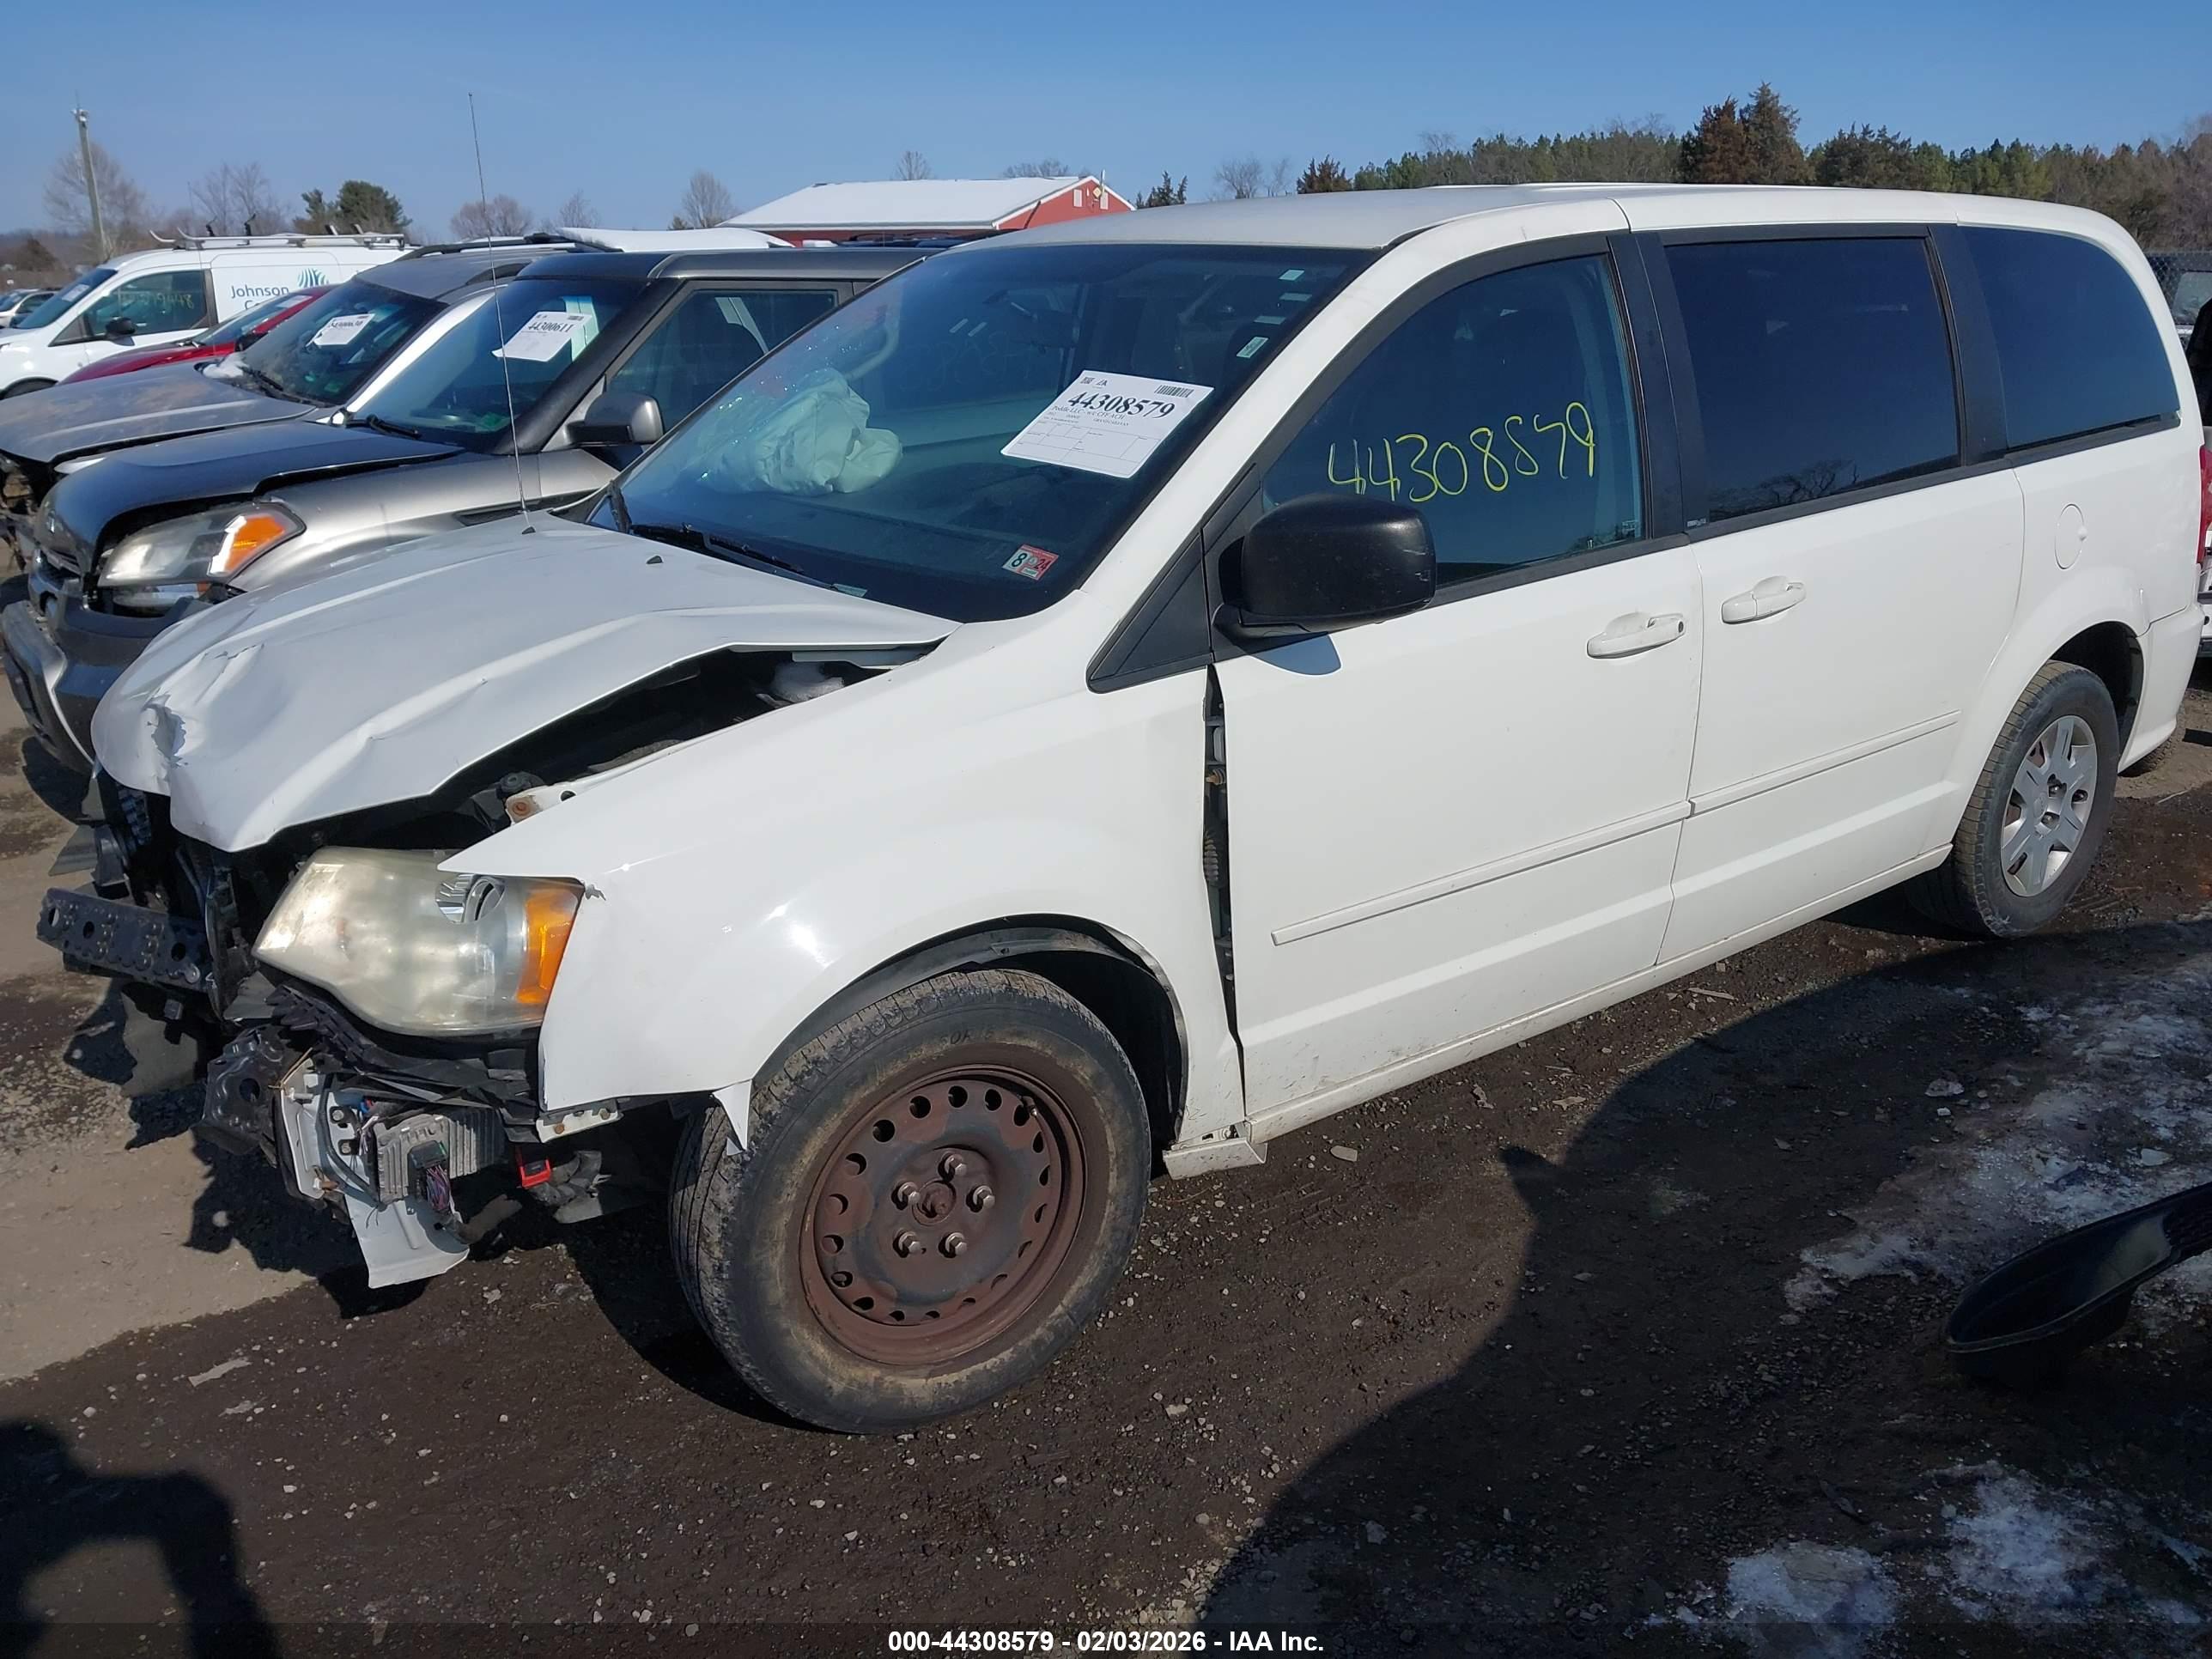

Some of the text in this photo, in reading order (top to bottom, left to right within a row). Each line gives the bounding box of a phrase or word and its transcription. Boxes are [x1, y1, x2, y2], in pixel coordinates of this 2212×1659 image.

[230, 284, 289, 299] Johnson
[528, 320, 575, 333] 44300611
[1067, 391, 1176, 419] 44308579
[1328, 401, 1596, 502] 44308579
[1011, 552, 1028, 568] 8
[1034, 558, 1053, 571] 24
